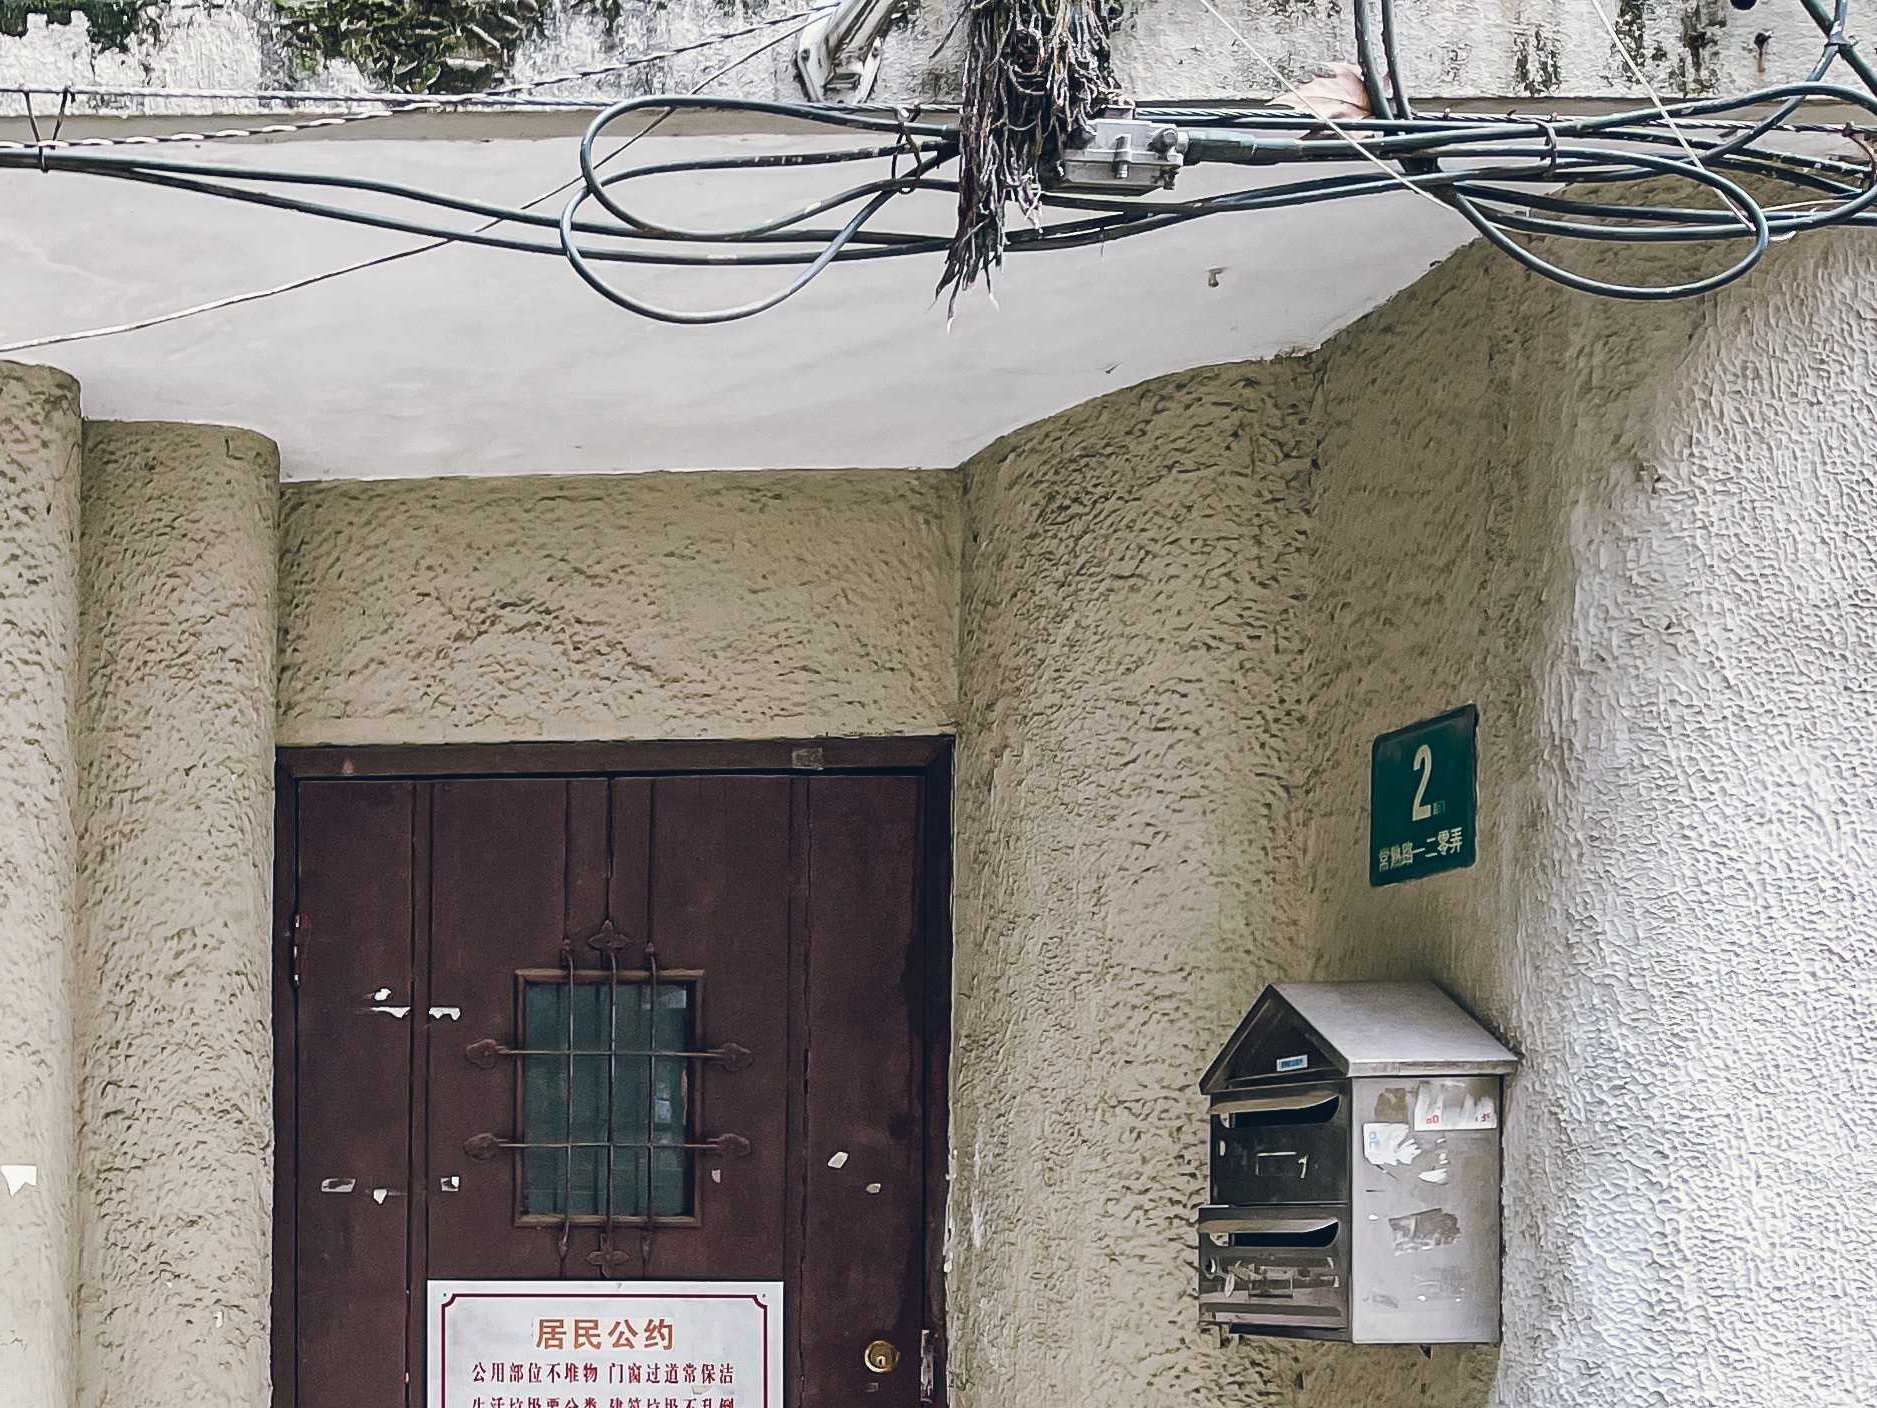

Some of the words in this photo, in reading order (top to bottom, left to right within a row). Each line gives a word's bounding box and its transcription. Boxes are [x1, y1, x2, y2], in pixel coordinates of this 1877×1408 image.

[1412, 744, 1432, 821] 2
[536, 1318, 674, 1350] 居民公约
[471, 1362, 598, 1384] 公用部位不堆物
[609, 1362, 734, 1384] 门窗过道常保洁
